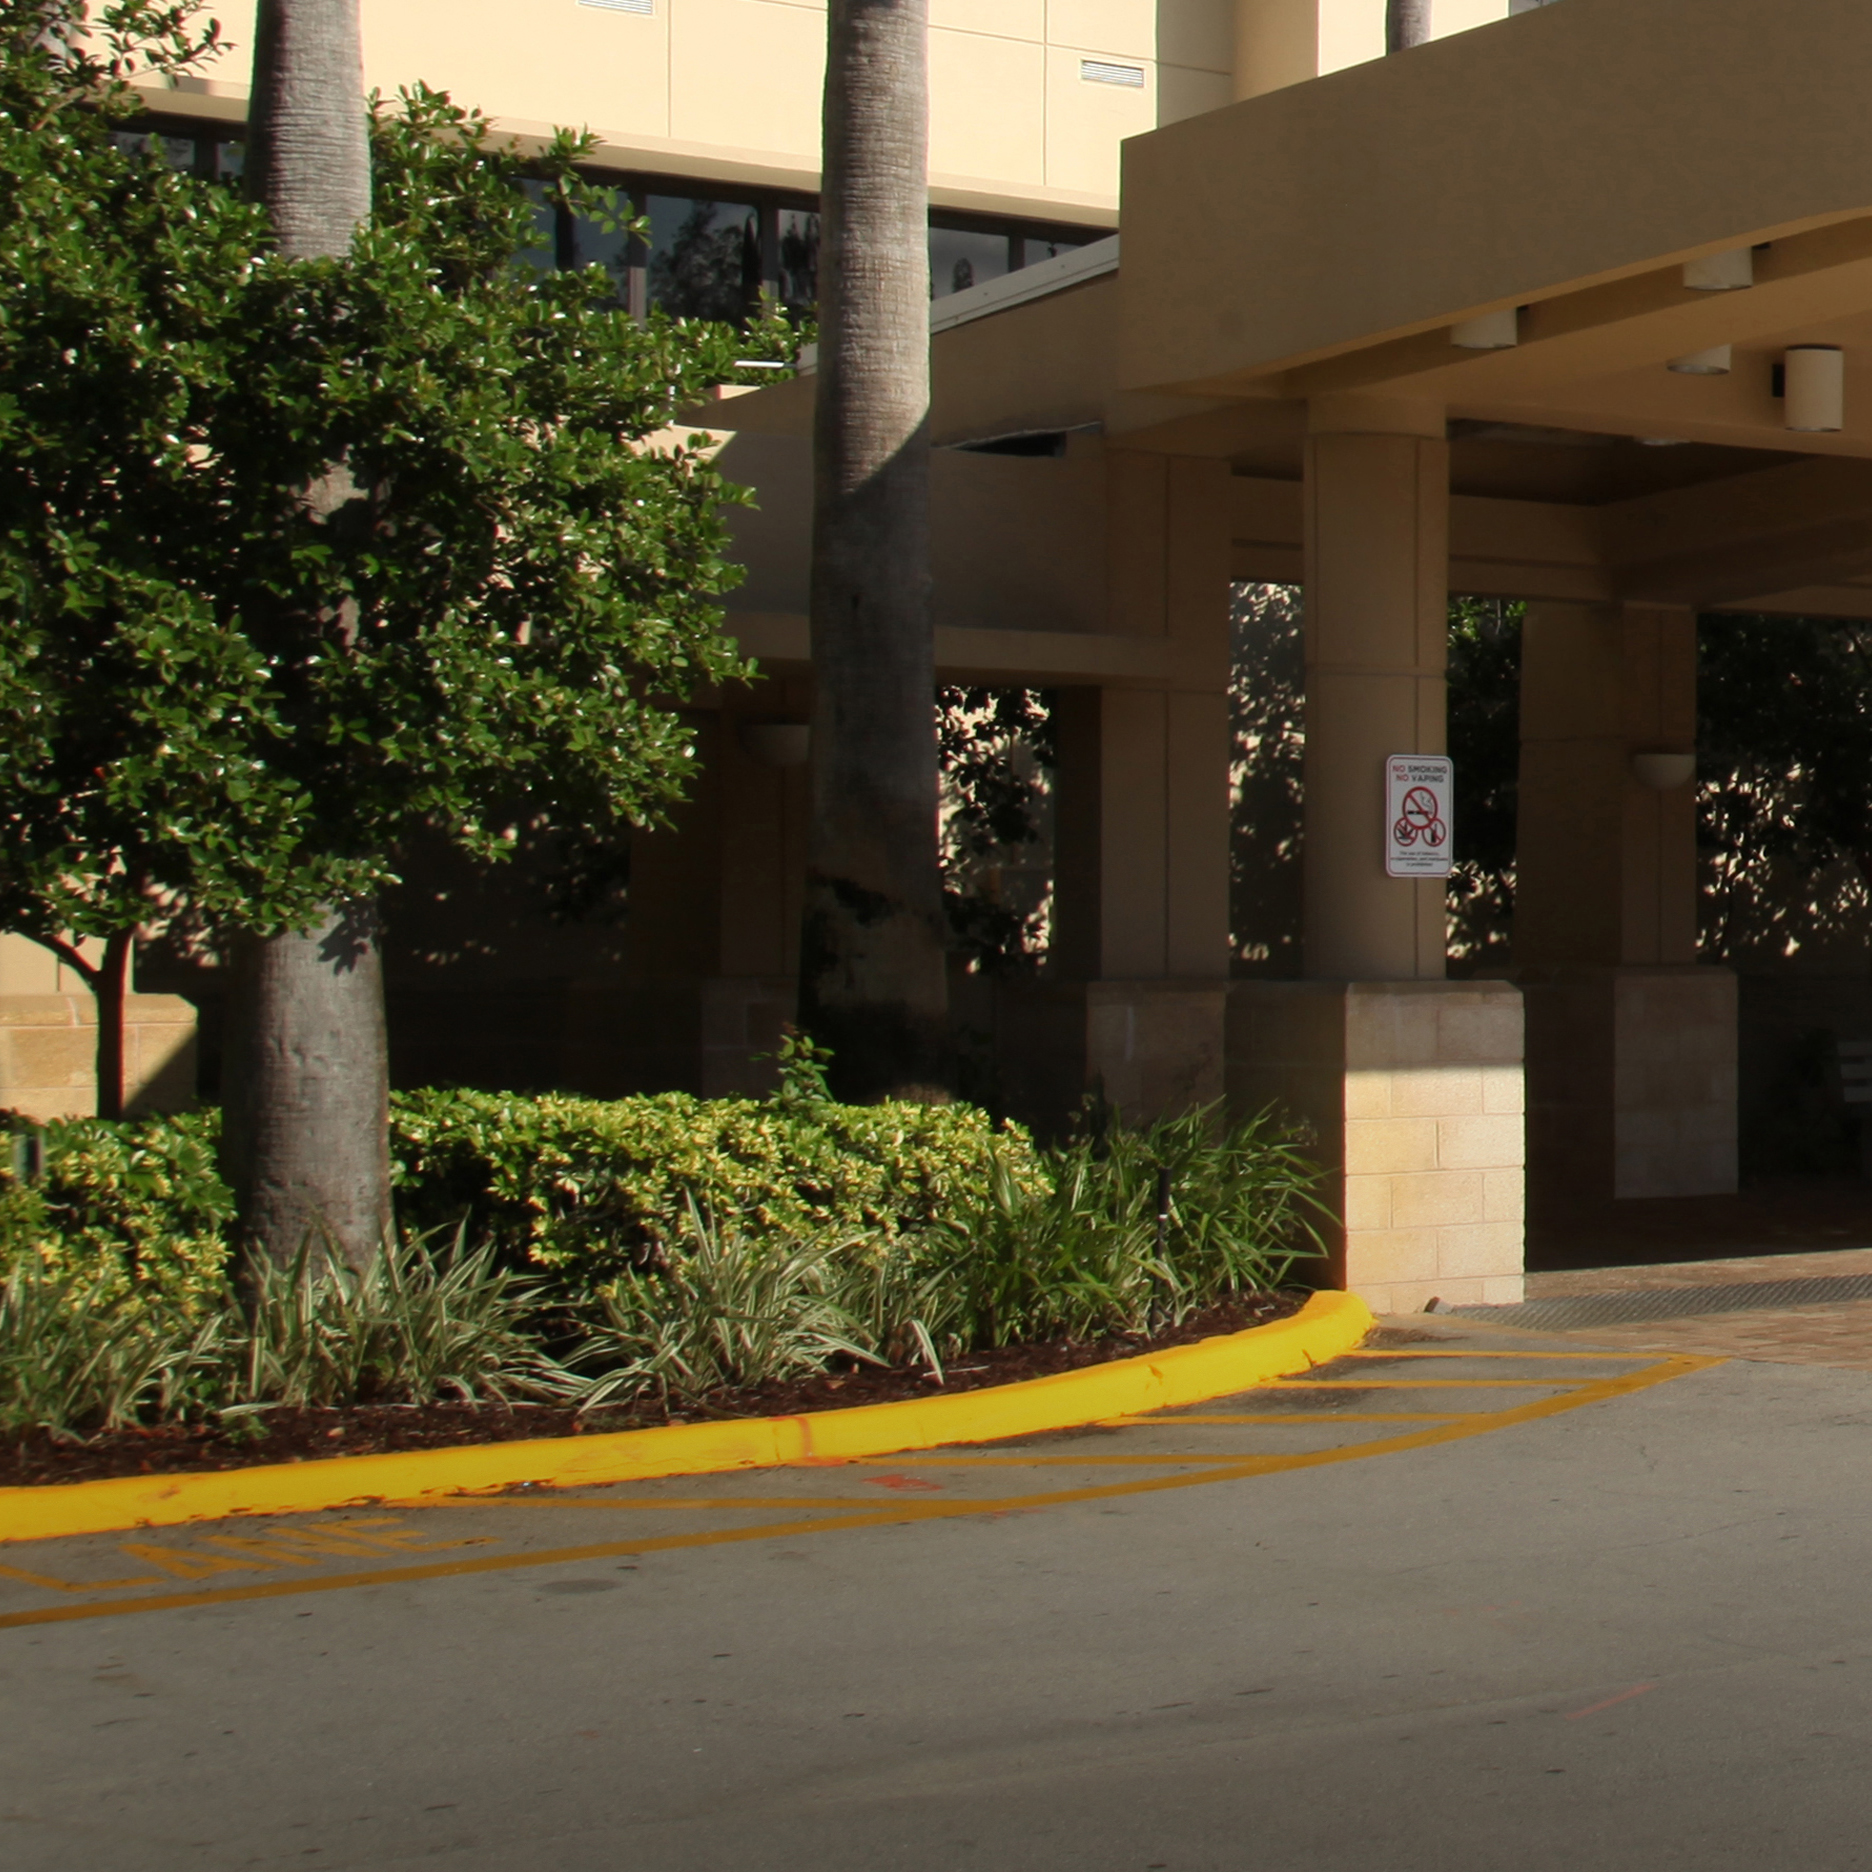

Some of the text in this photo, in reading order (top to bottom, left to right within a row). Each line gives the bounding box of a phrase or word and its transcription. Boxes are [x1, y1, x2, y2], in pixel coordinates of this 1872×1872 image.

[1393, 765, 1448, 774] NO SMOKING
[1396, 774, 1445, 783] NO VAPING
[0, 1517, 500, 1592] LANE
